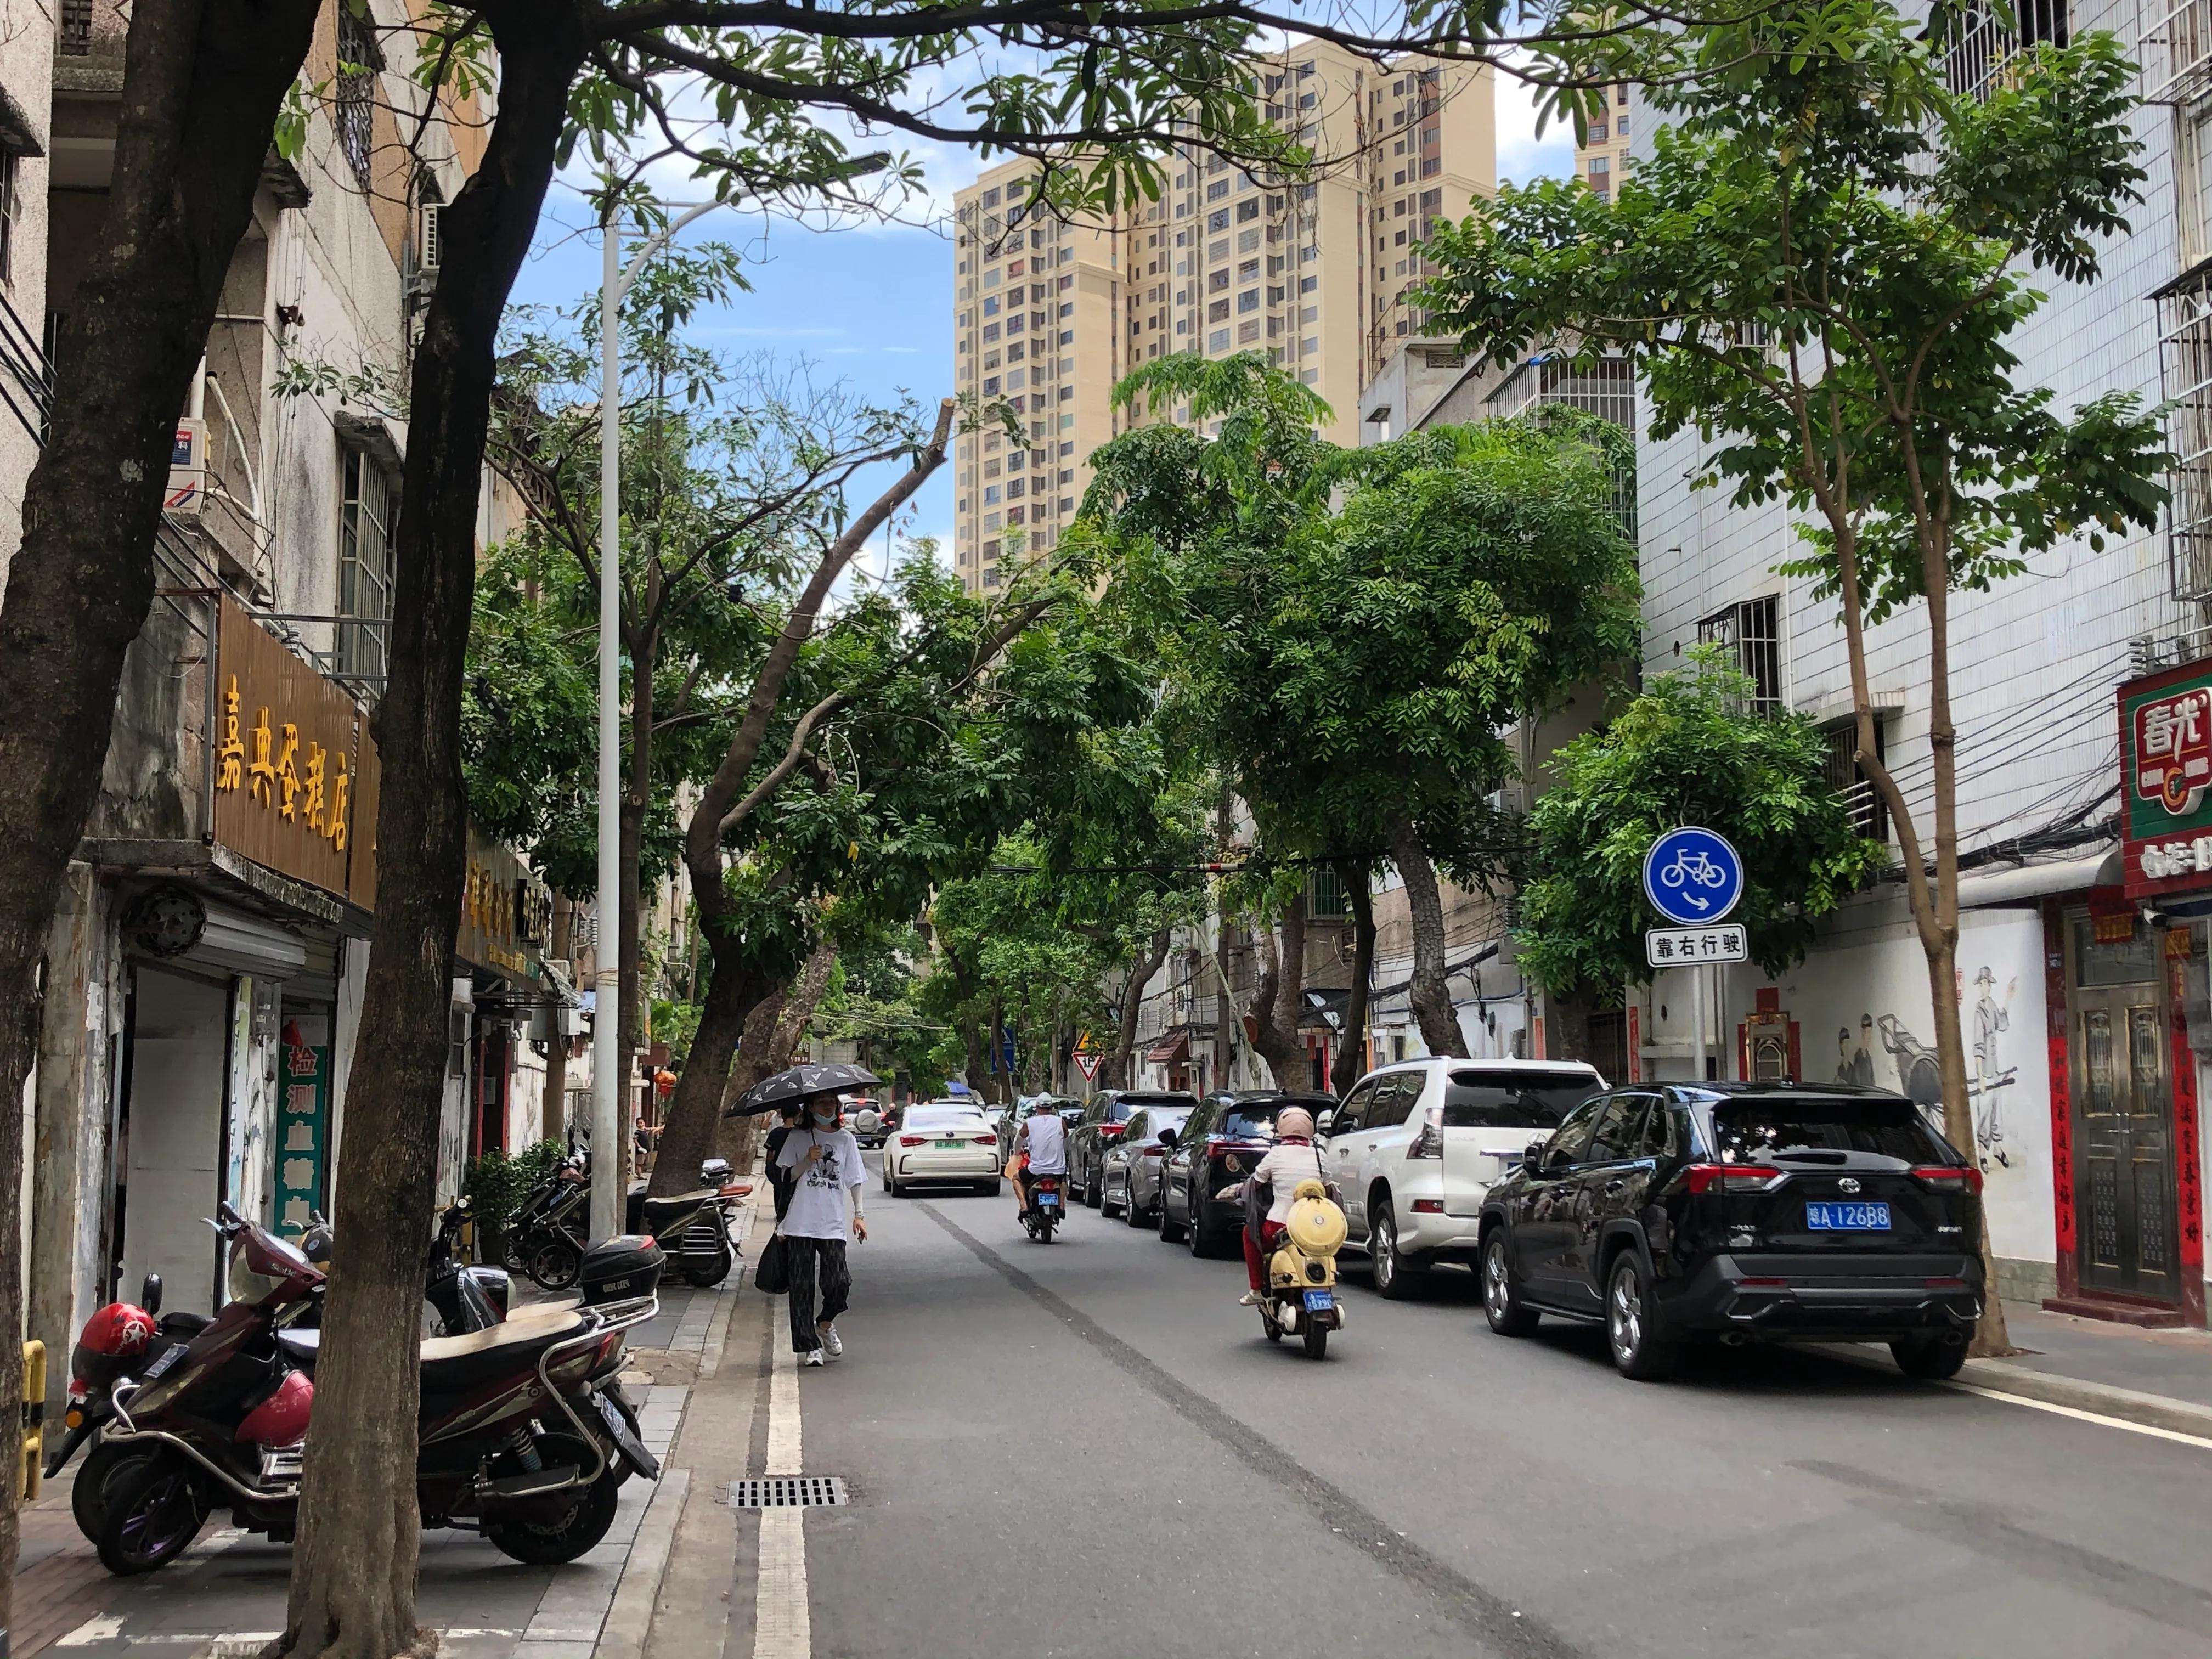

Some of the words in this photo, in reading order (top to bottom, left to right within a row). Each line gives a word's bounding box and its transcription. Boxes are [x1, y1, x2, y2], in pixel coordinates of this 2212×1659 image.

[2143, 696, 2202, 763] 春光
[217, 674, 348, 851] 嘉典蛋糕店
[1656, 932, 1741, 958] 靠右行驶
[1082, 1057, 1094, 1068] 让
